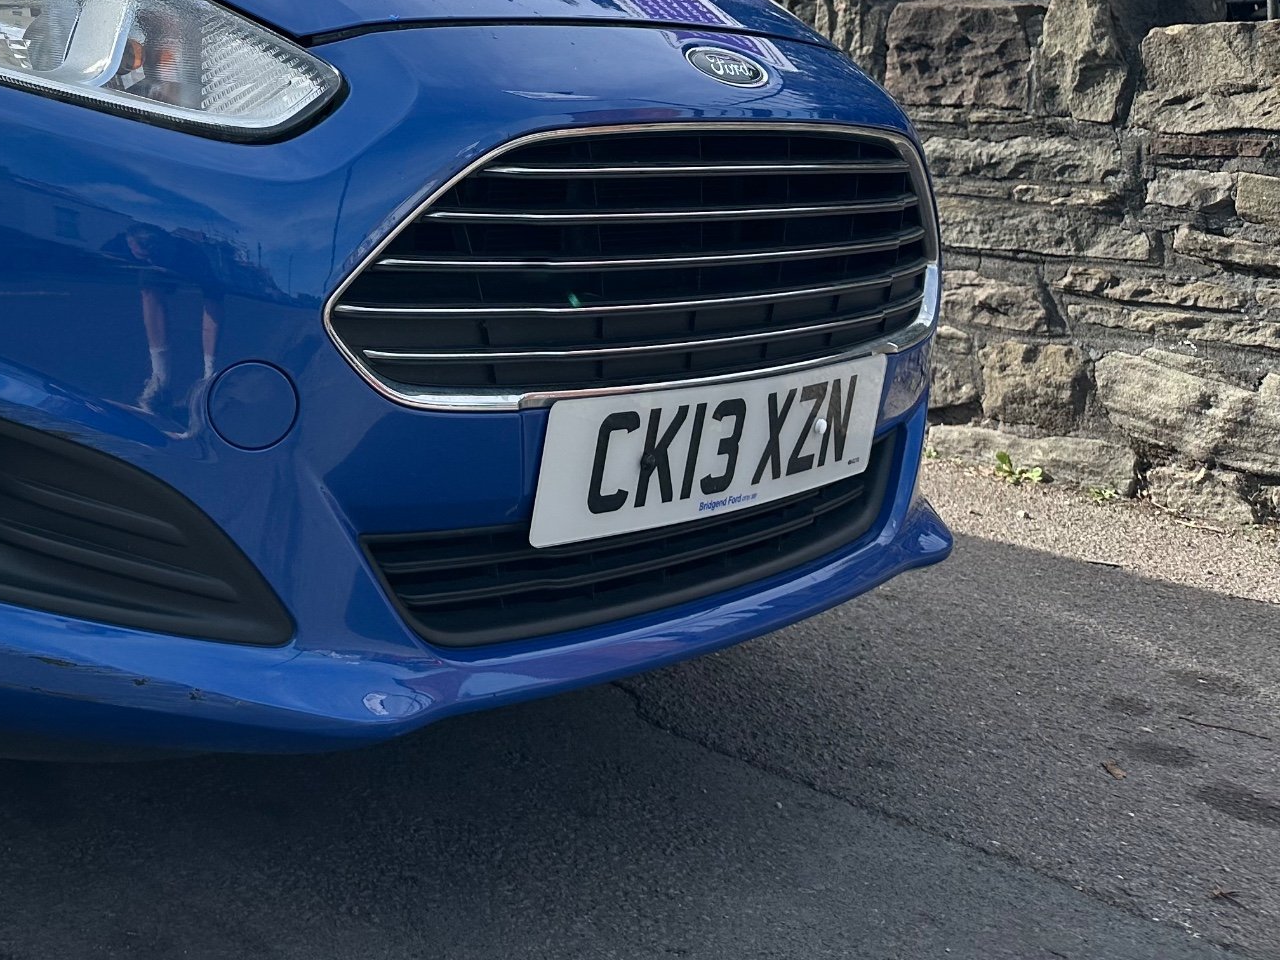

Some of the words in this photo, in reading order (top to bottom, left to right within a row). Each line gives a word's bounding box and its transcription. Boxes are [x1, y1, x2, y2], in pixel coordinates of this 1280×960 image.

[706, 54, 753, 77] Ford
[587, 397, 747, 515] CK13
[750, 374, 858, 486] XZN
[698, 497, 727, 512] Bridgend
[727, 494, 742, 505] Ford
